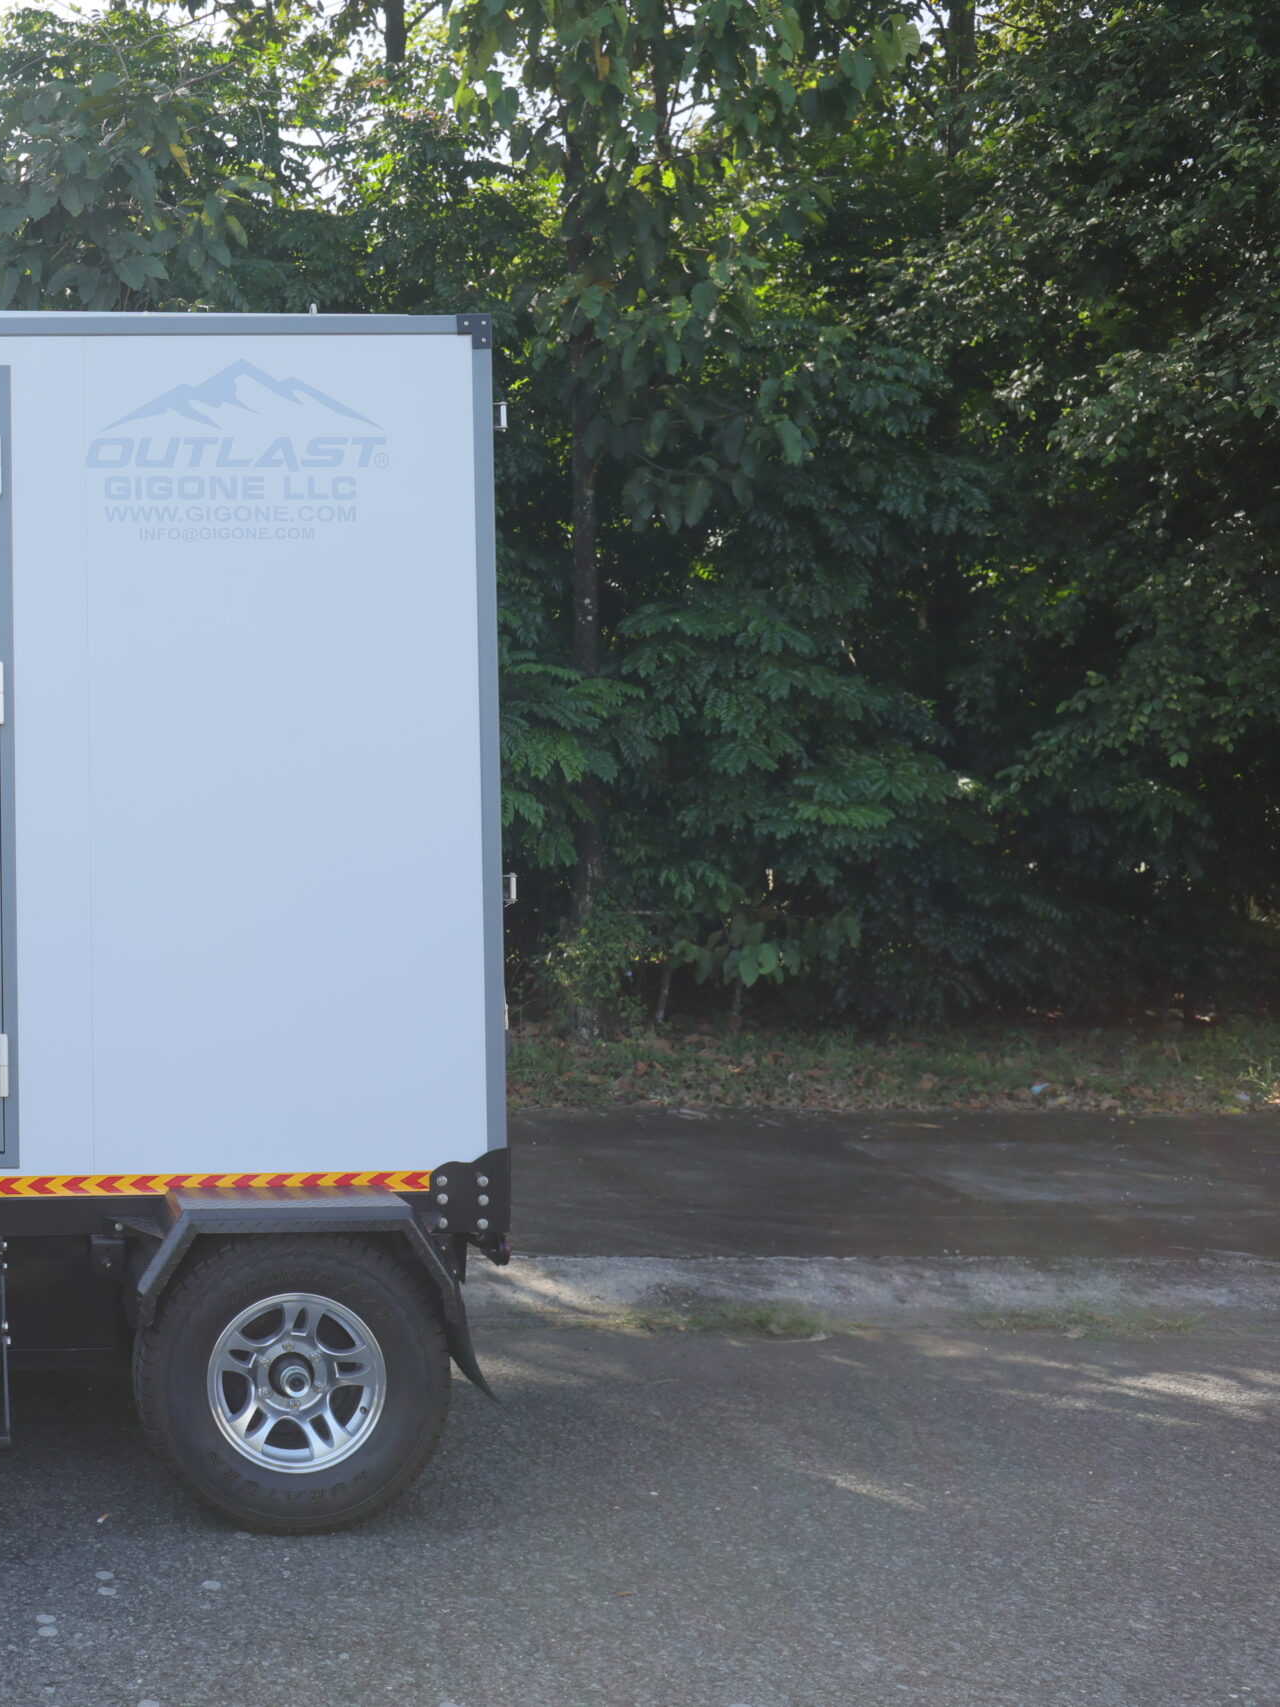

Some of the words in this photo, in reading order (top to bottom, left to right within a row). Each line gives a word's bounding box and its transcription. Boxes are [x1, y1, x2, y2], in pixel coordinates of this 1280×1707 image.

[104, 475, 265, 501] GIGONE
[283, 475, 357, 501] LLC
[104, 505, 357, 523] WWW.GIGONE.COM
[138, 527, 316, 543] INFO@GIGONE.COM
